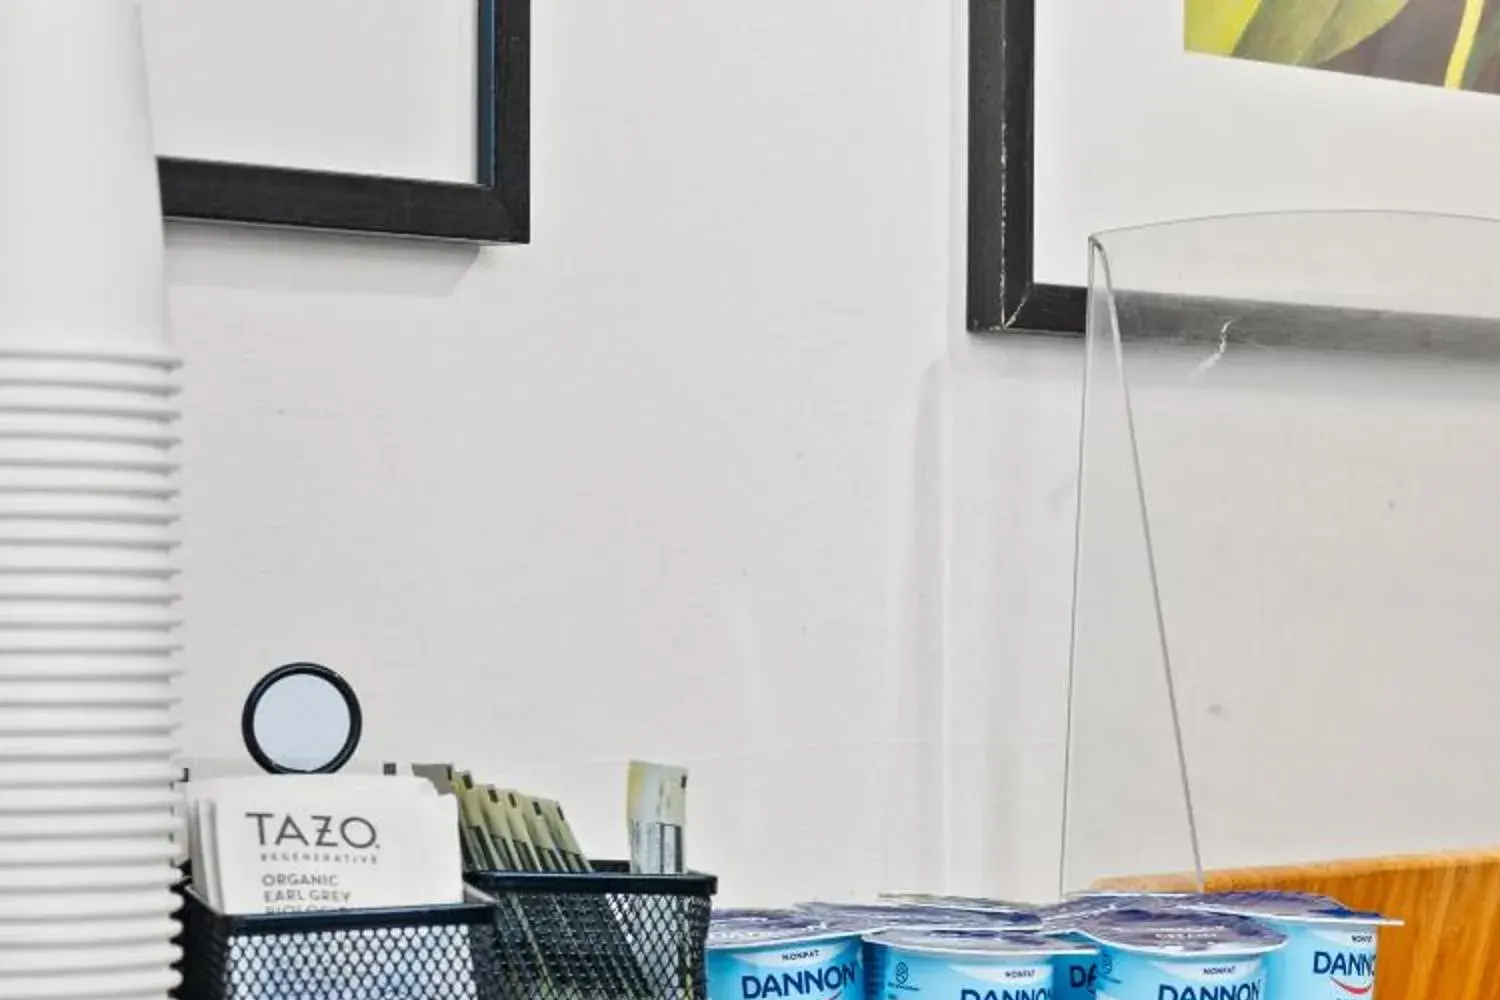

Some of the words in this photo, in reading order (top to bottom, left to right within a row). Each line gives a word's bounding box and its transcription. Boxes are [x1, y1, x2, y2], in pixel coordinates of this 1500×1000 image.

[245, 812, 378, 849] TAZO
[261, 873, 339, 887] ORGANIC
[263, 888, 304, 902] EARL
[309, 889, 352, 903] GREY
[741, 963, 856, 1000] DANNON
